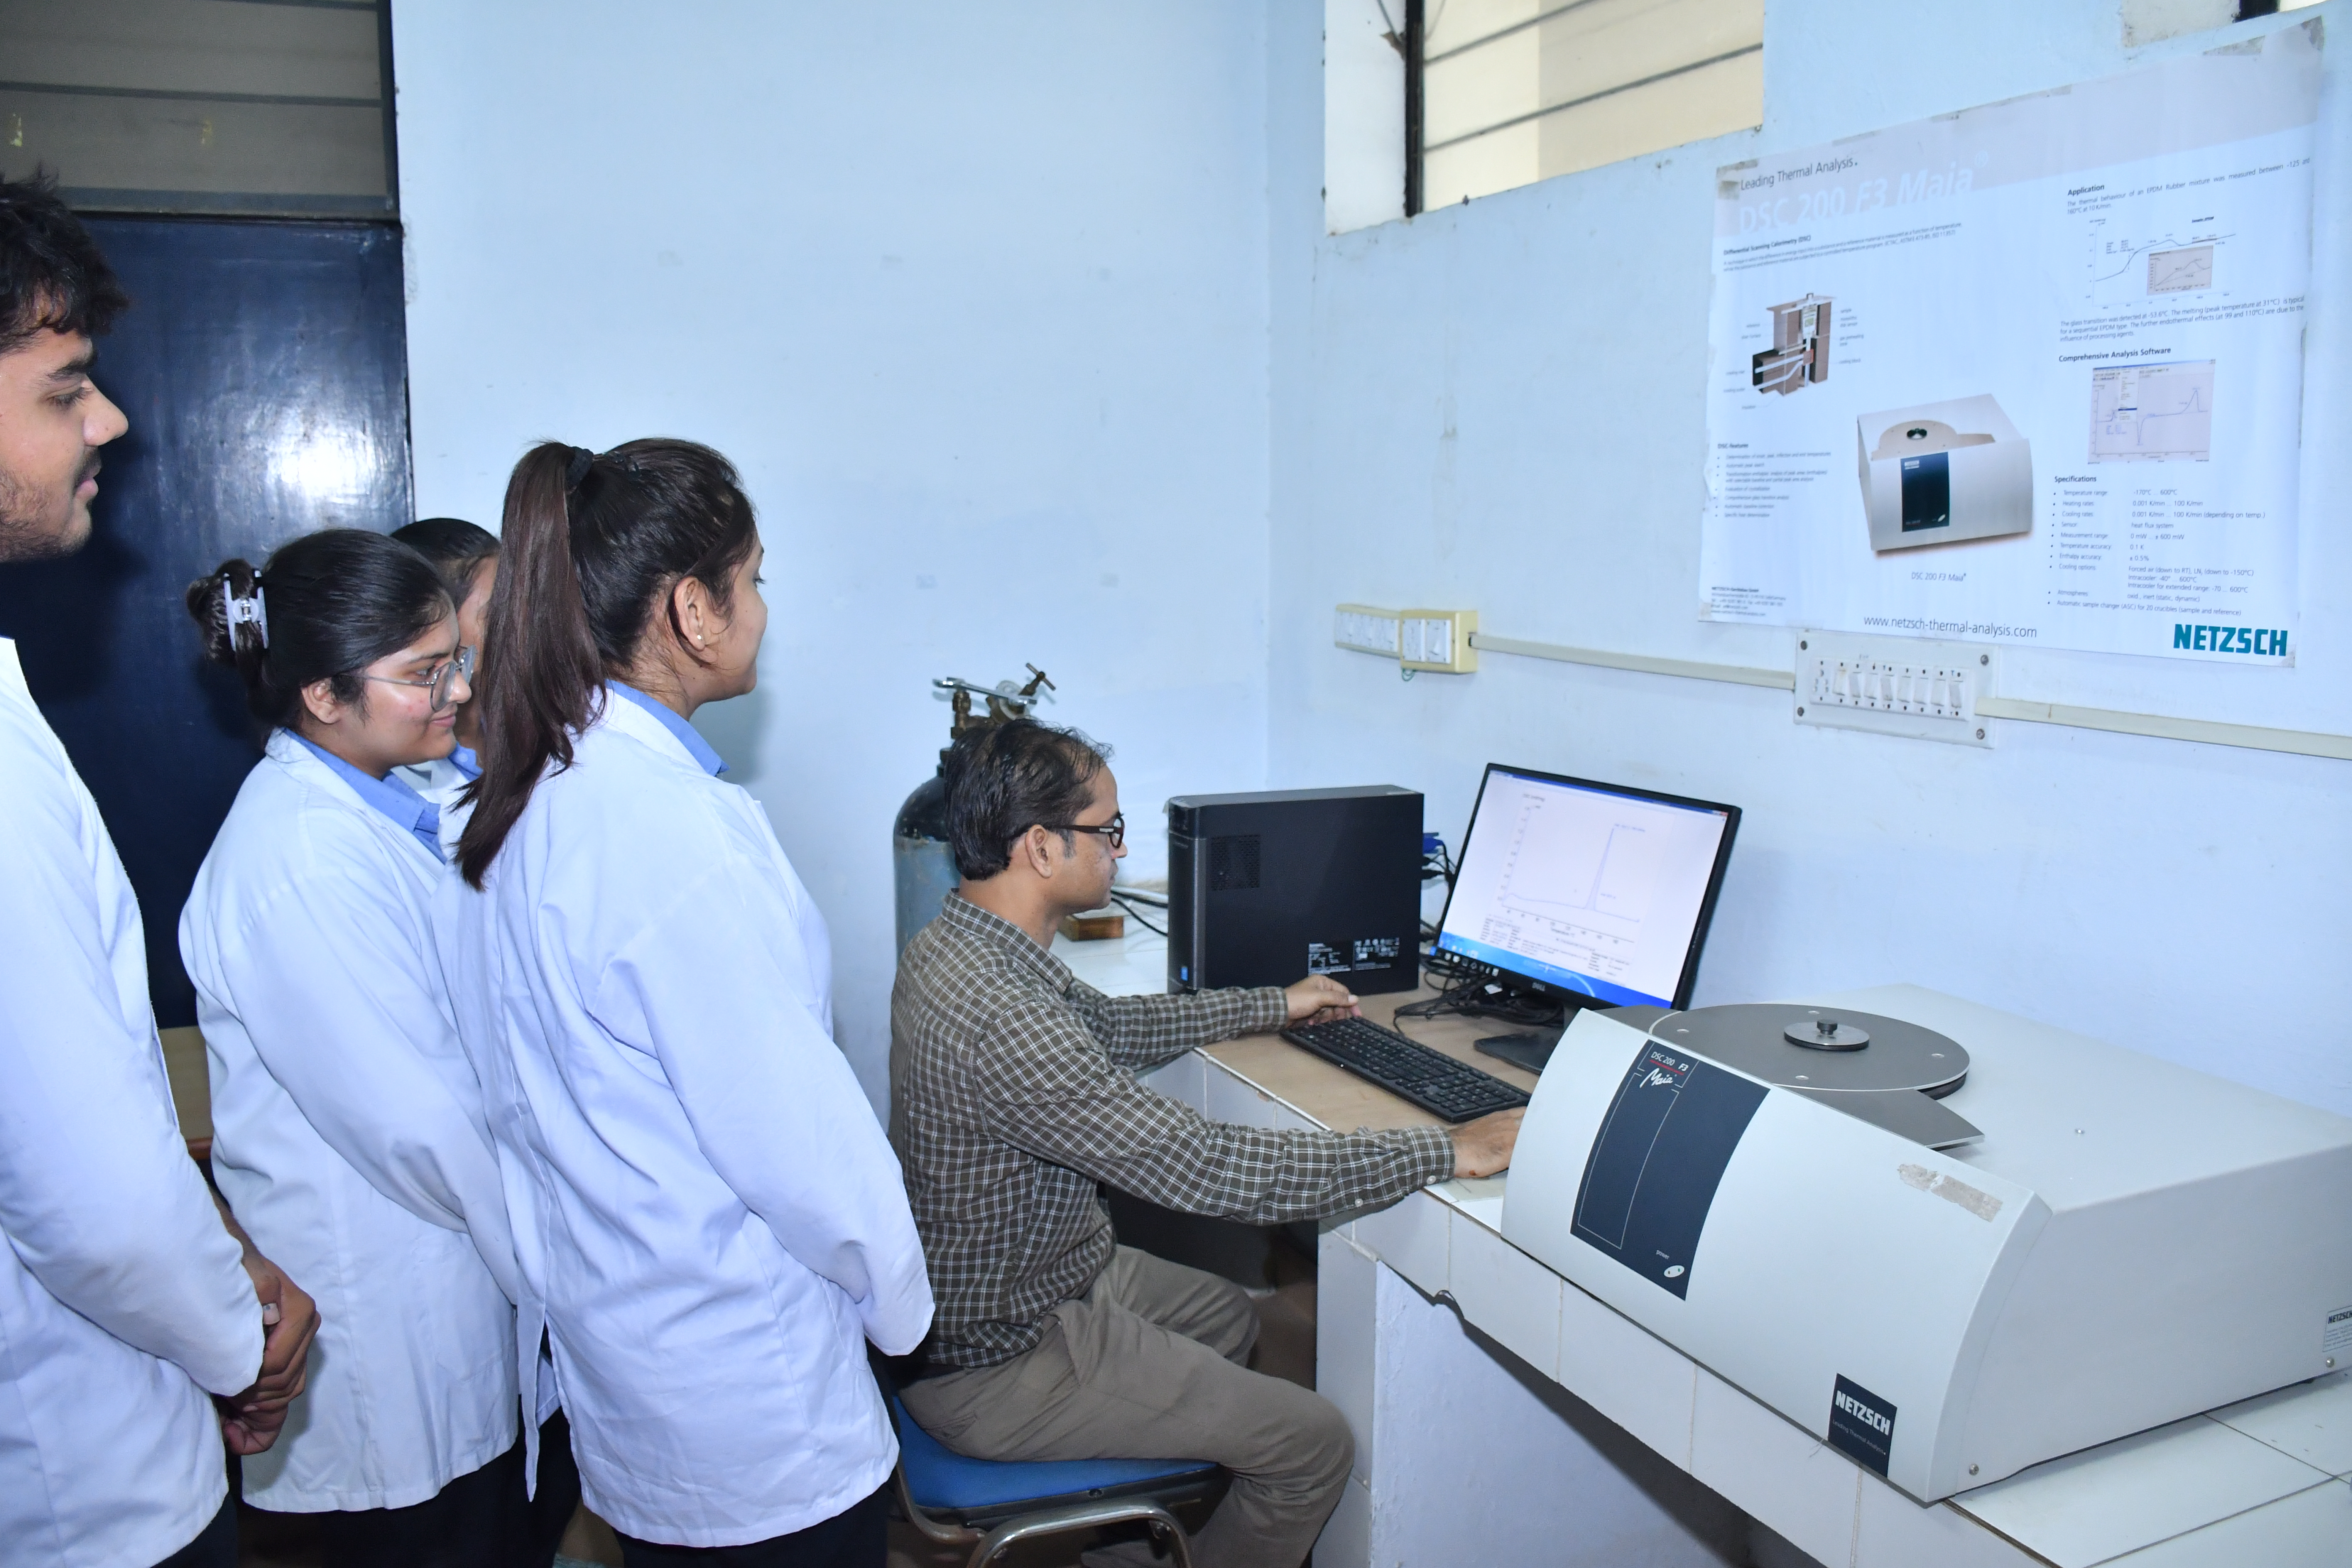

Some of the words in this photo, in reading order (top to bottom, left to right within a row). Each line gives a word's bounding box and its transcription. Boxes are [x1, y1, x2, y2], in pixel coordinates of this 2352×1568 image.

[1741, 174, 1774, 191] Leading
[1778, 164, 1813, 182] Thermal
[1816, 157, 1858, 174] Analysis.
[2079, 196, 2098, 205] thermal
[2147, 185, 2162, 193] EPDM
[2166, 182, 2185, 190] Rubber
[2189, 178, 2210, 186] mixture
[2229, 169, 2256, 180] measured
[2259, 164, 2283, 174] between
[2287, 160, 2299, 168] -125
[2068, 184, 2104, 196] Application
[1739, 197, 1791, 234] DSC
[1797, 187, 1846, 222] 200
[1857, 178, 1888, 212] F3
[2119, 313, 2141, 322] detected
[2182, 307, 2203, 315] melting
[2205, 305, 2220, 313] (peak
[2222, 302, 2255, 311] temperature
[2289, 295, 2305, 304] typical
[2073, 326, 2098, 334] sequential
[2159, 316, 2193, 325] endothermal
[2195, 313, 2214, 321] effects
[2089, 332, 2116, 340] processing
[2059, 352, 2109, 362] Comprehensive
[2111, 349, 2138, 358] Analysis
[2140, 347, 2171, 356] Software
[2055, 475, 2096, 484] Specifications
[1911, 572, 1923, 580] DSC
[1925, 572, 1937, 580] 200
[1864, 617, 2036, 638] www.netzsch-thermal-analysis.com
[2173, 624, 2288, 656] NETZSCH
[1650, 1051, 1665, 1062] DSC
[1662, 1056, 1675, 1066] 200
[1678, 1063, 1689, 1071] F3
[1656, 1250, 1670, 1260] power
[1835, 1390, 1891, 1436] NETZSCH
[1832, 1419, 1849, 1434] Leading
[1849, 1429, 1866, 1443] Thermal
